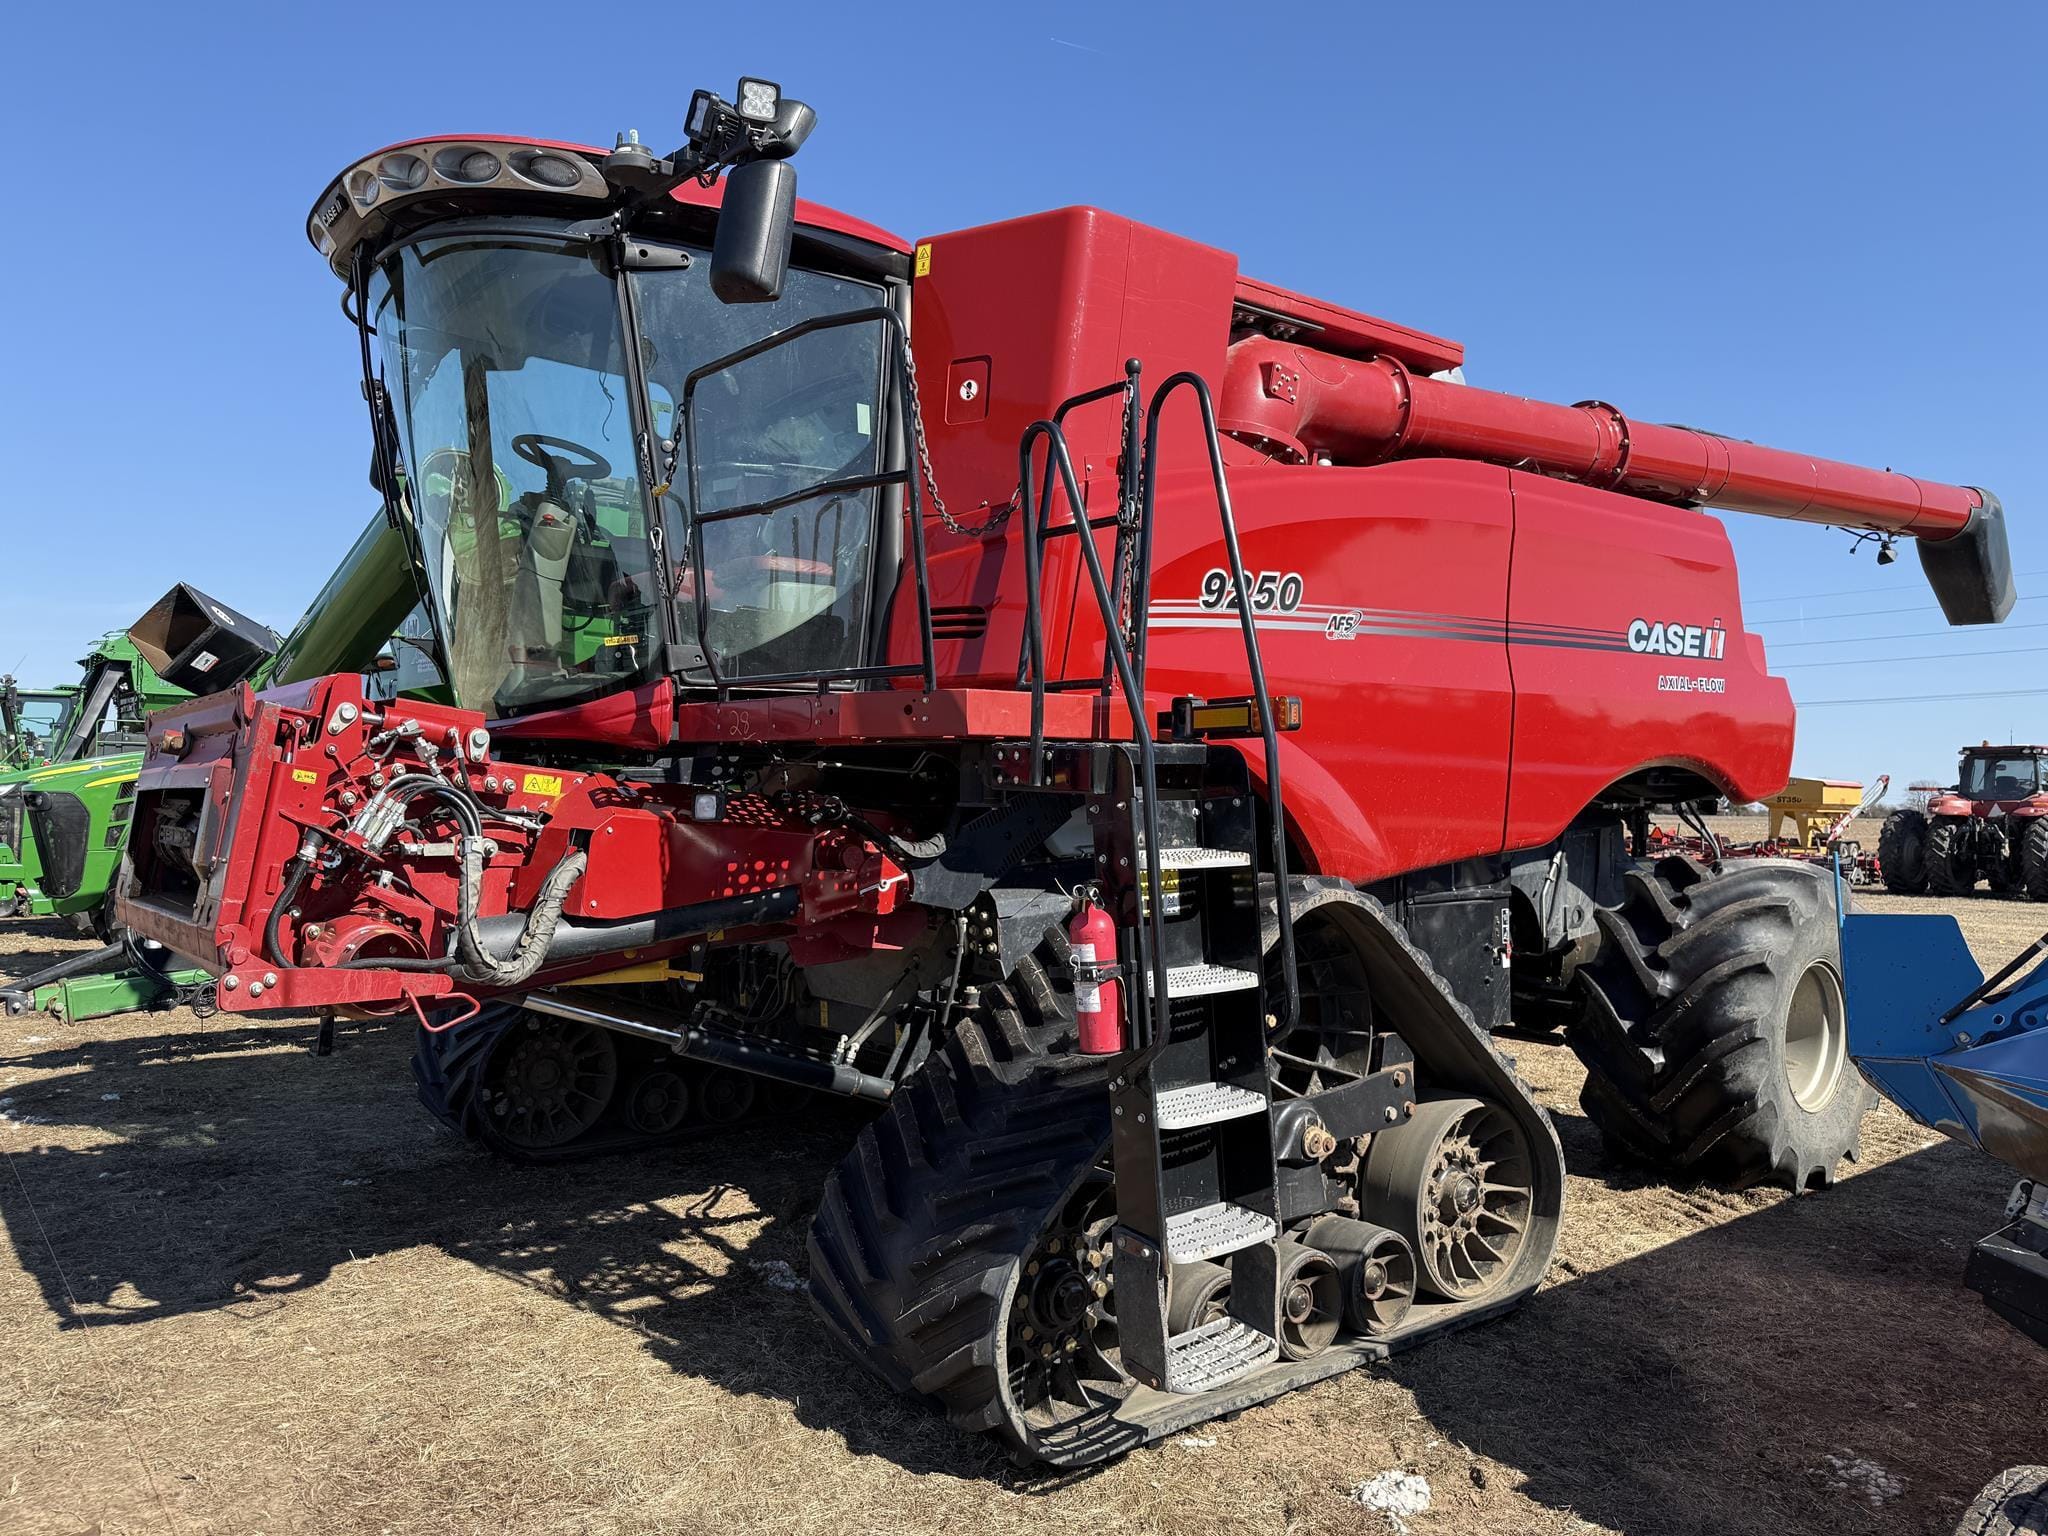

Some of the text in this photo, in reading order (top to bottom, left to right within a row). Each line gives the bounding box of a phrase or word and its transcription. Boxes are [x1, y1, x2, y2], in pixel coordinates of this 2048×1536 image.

[322, 205, 338, 228] CASE
[1200, 568, 1303, 614] 9250
[1327, 615, 1355, 632] AFS
[1627, 618, 1702, 656] CASE
[1658, 675, 1725, 693] AXIAL-FLOW
